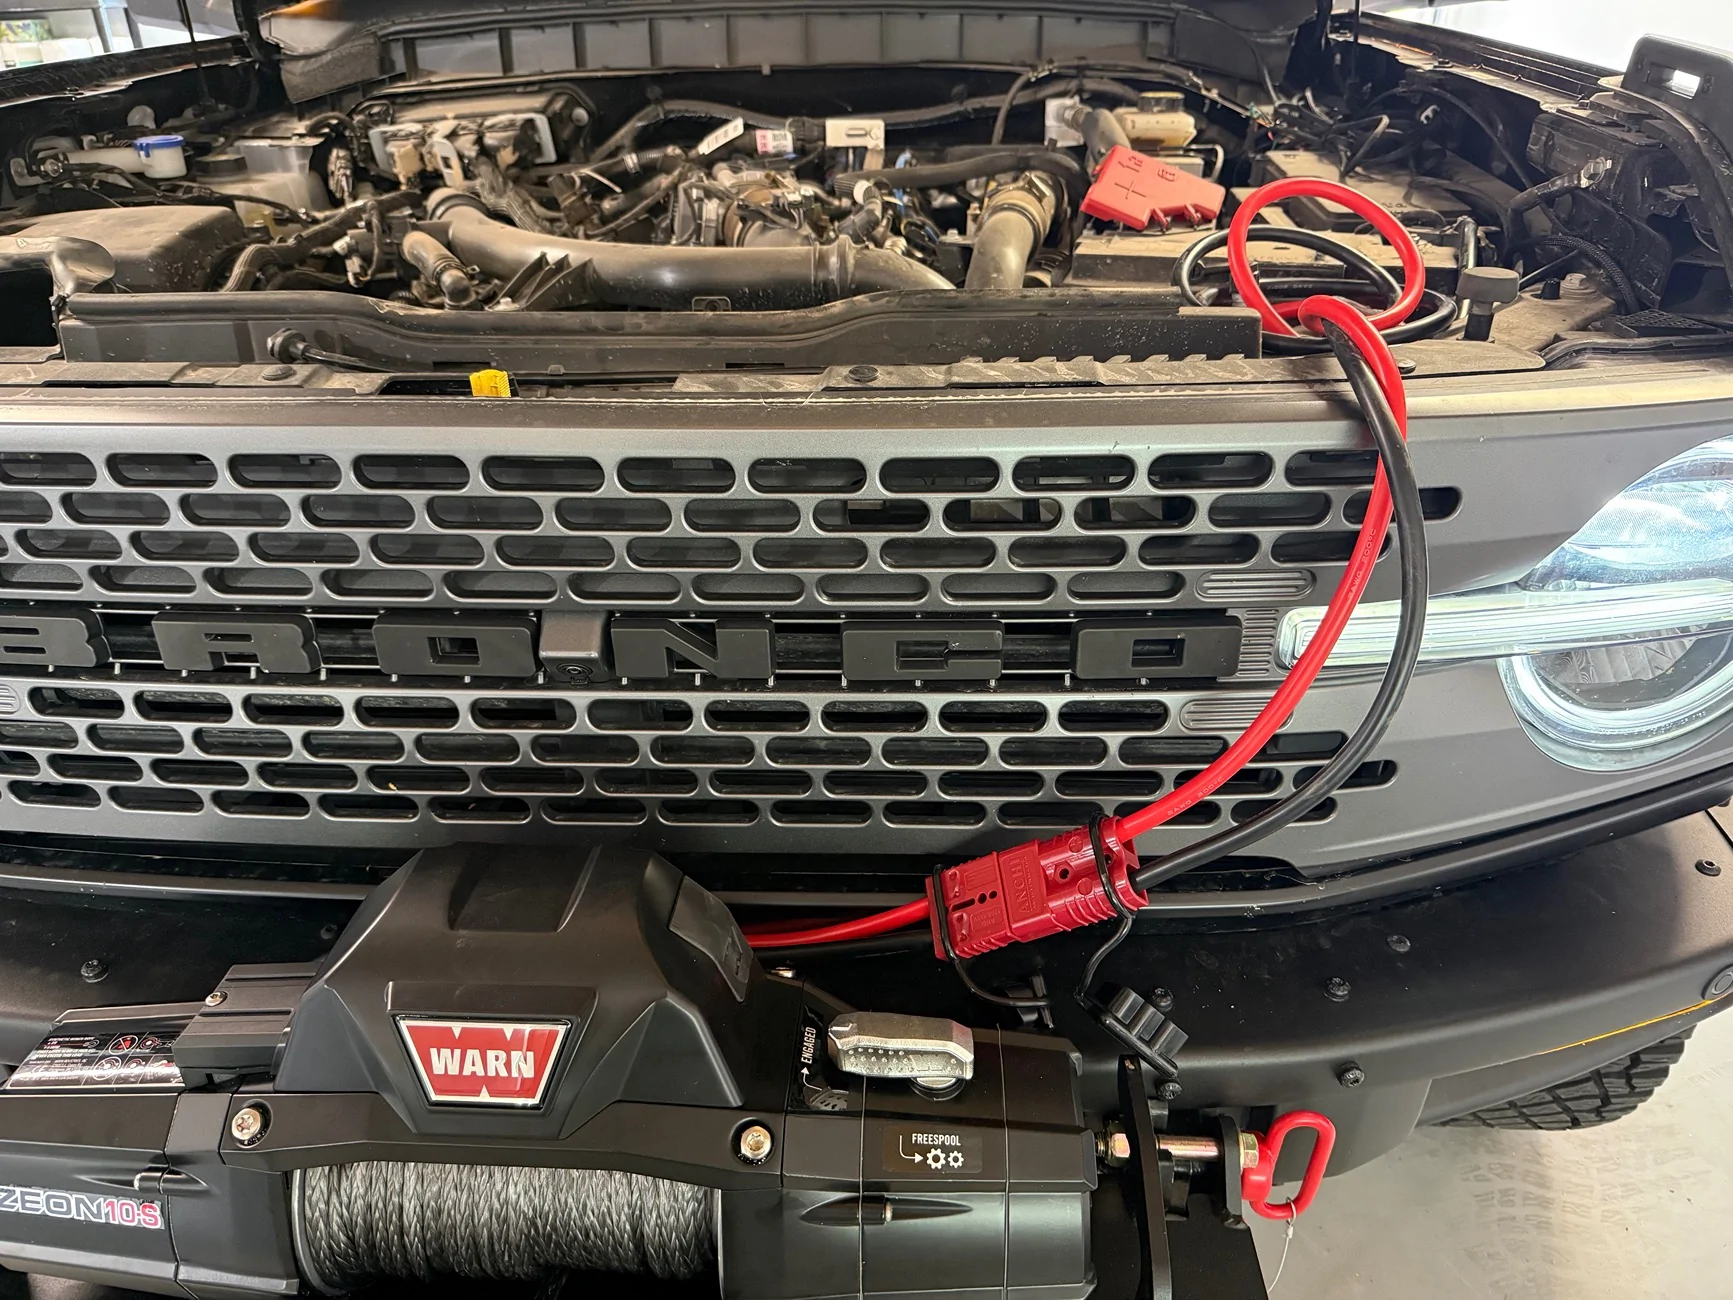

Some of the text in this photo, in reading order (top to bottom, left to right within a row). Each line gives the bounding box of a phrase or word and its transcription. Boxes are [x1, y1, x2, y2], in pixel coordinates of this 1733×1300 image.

[0, 609, 1242, 679] BRONCO
[801, 1026, 817, 1064] ENGAGED
[429, 1047, 535, 1078] WARN
[912, 1133, 961, 1146] FREESPOOL
